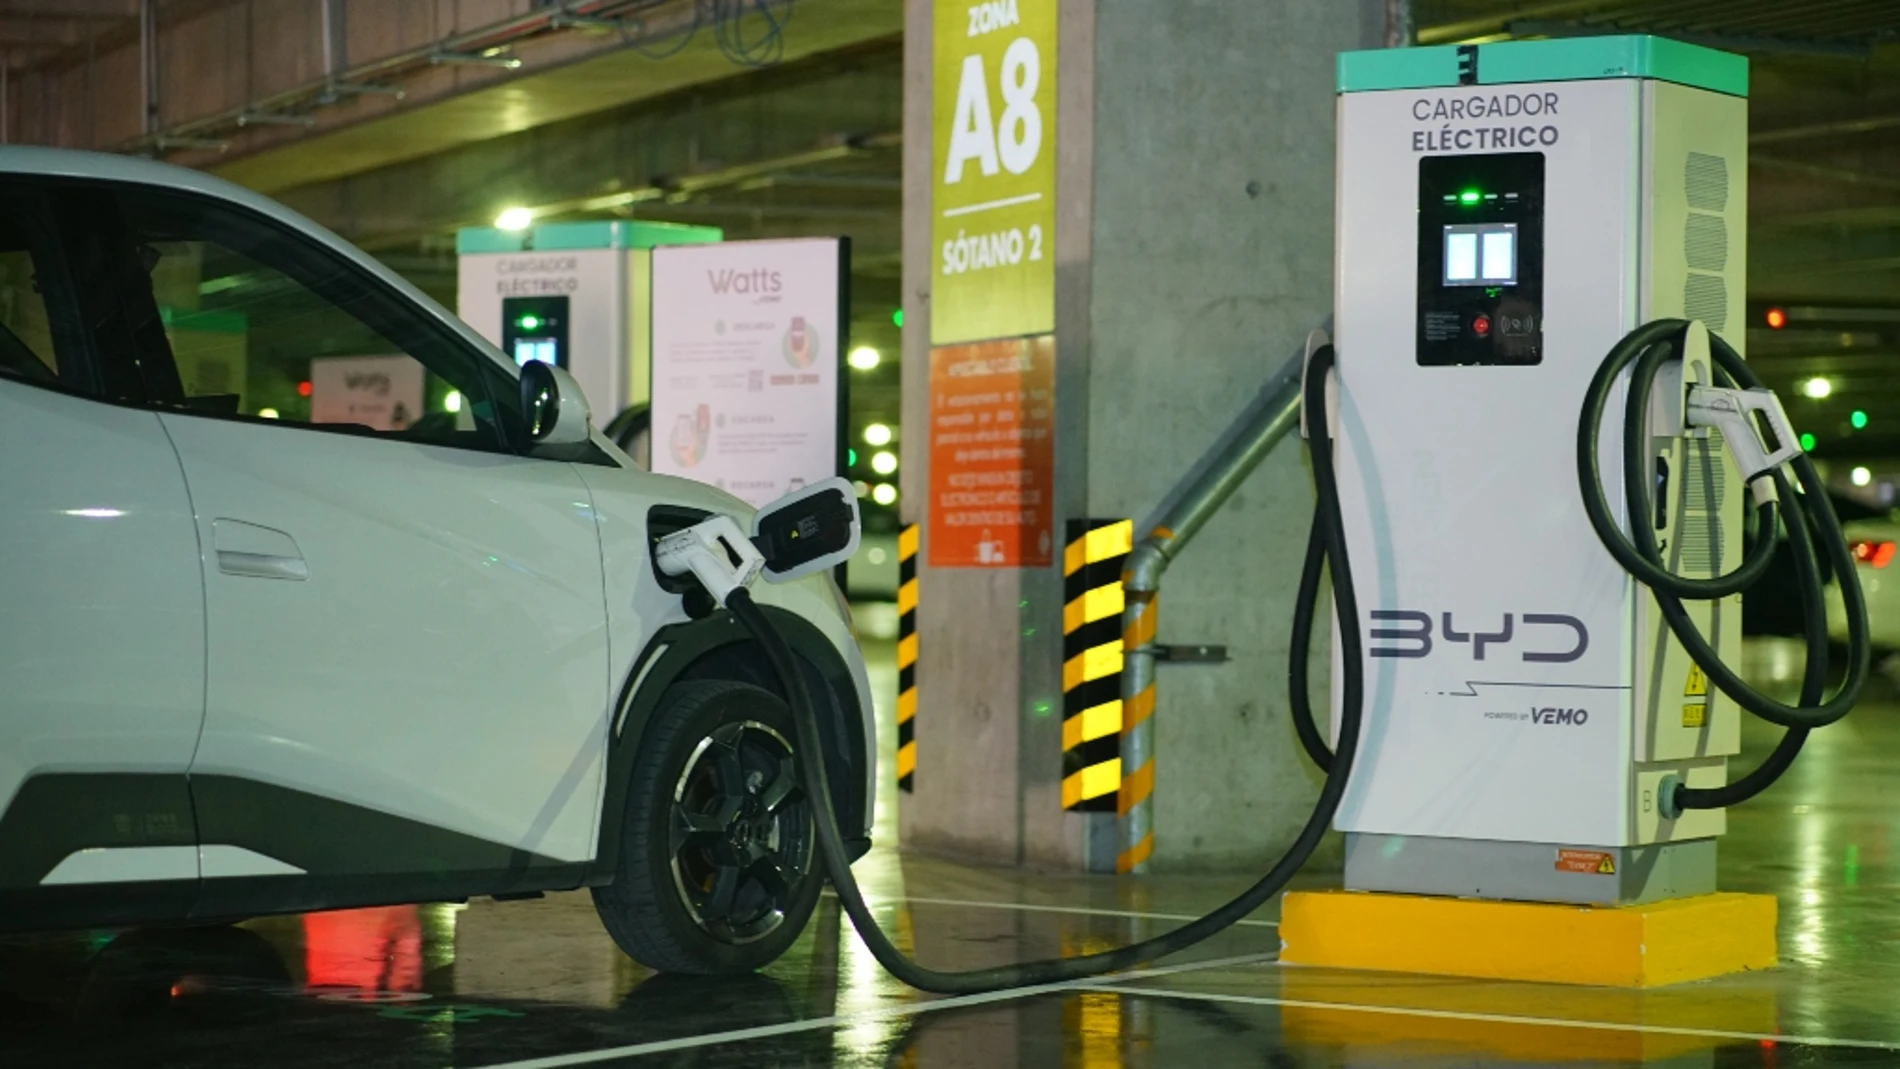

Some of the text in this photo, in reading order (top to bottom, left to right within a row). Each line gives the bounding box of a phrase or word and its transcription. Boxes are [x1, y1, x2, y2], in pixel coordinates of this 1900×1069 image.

[967, 0, 1020, 37] ZONA
[944, 37, 1042, 184] A8
[1412, 93, 1559, 121] CARGADOR
[1412, 124, 1559, 152] ELÉCTRICO
[942, 224, 1043, 275] SÓTANO 2
[707, 268, 782, 294] Watts
[1369, 610, 1589, 663] BYD
[1531, 707, 1588, 725] VEMO
